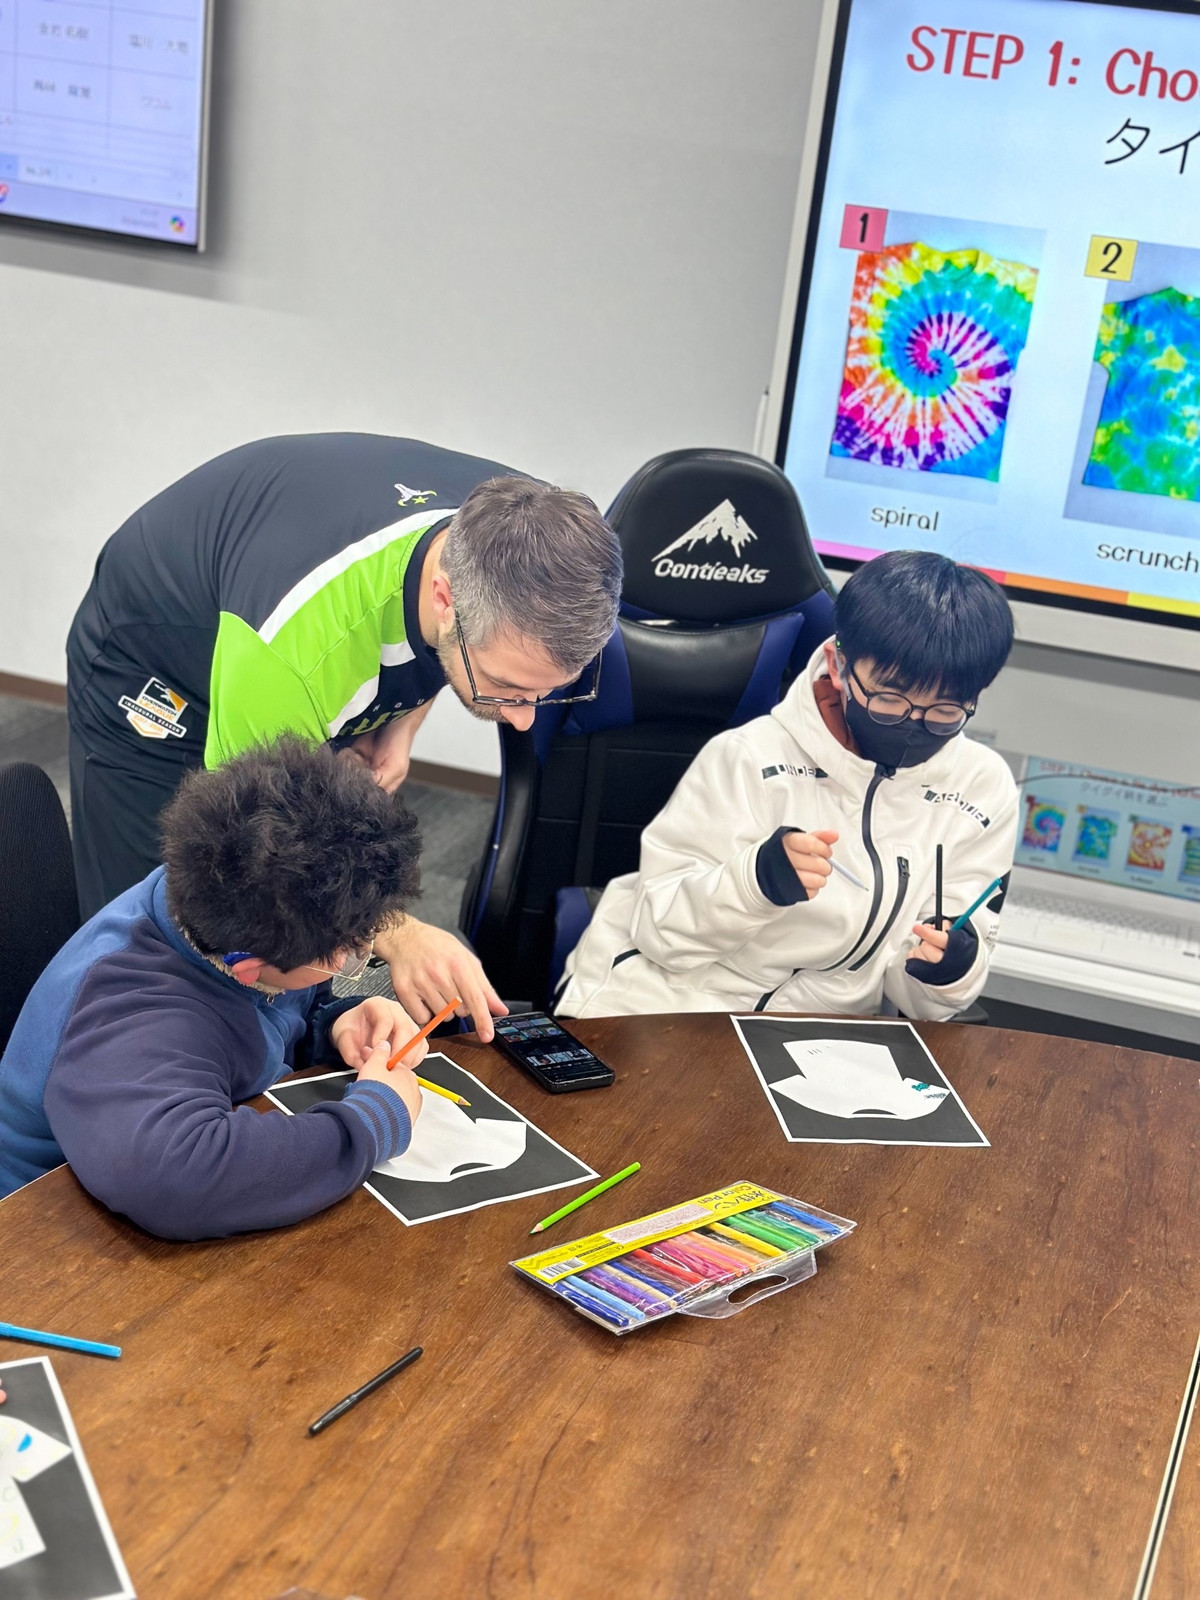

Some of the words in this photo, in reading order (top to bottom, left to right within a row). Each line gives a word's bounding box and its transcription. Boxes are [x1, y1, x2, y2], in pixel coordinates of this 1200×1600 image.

[906, 25, 1025, 80] STEP
[1048, 40, 1081, 86] 1:
[1105, 48, 1199, 102] Cho
[859, 212, 869, 243] 1
[1100, 242, 1123, 274] 2
[871, 505, 939, 531] spiral
[654, 558, 769, 584] Contieaks
[1096, 543, 1199, 573] scrunch
[124, 700, 157, 721] INAUGURAL
[142, 695, 177, 716] OVERWATCH
[157, 718, 181, 733] SEASON
